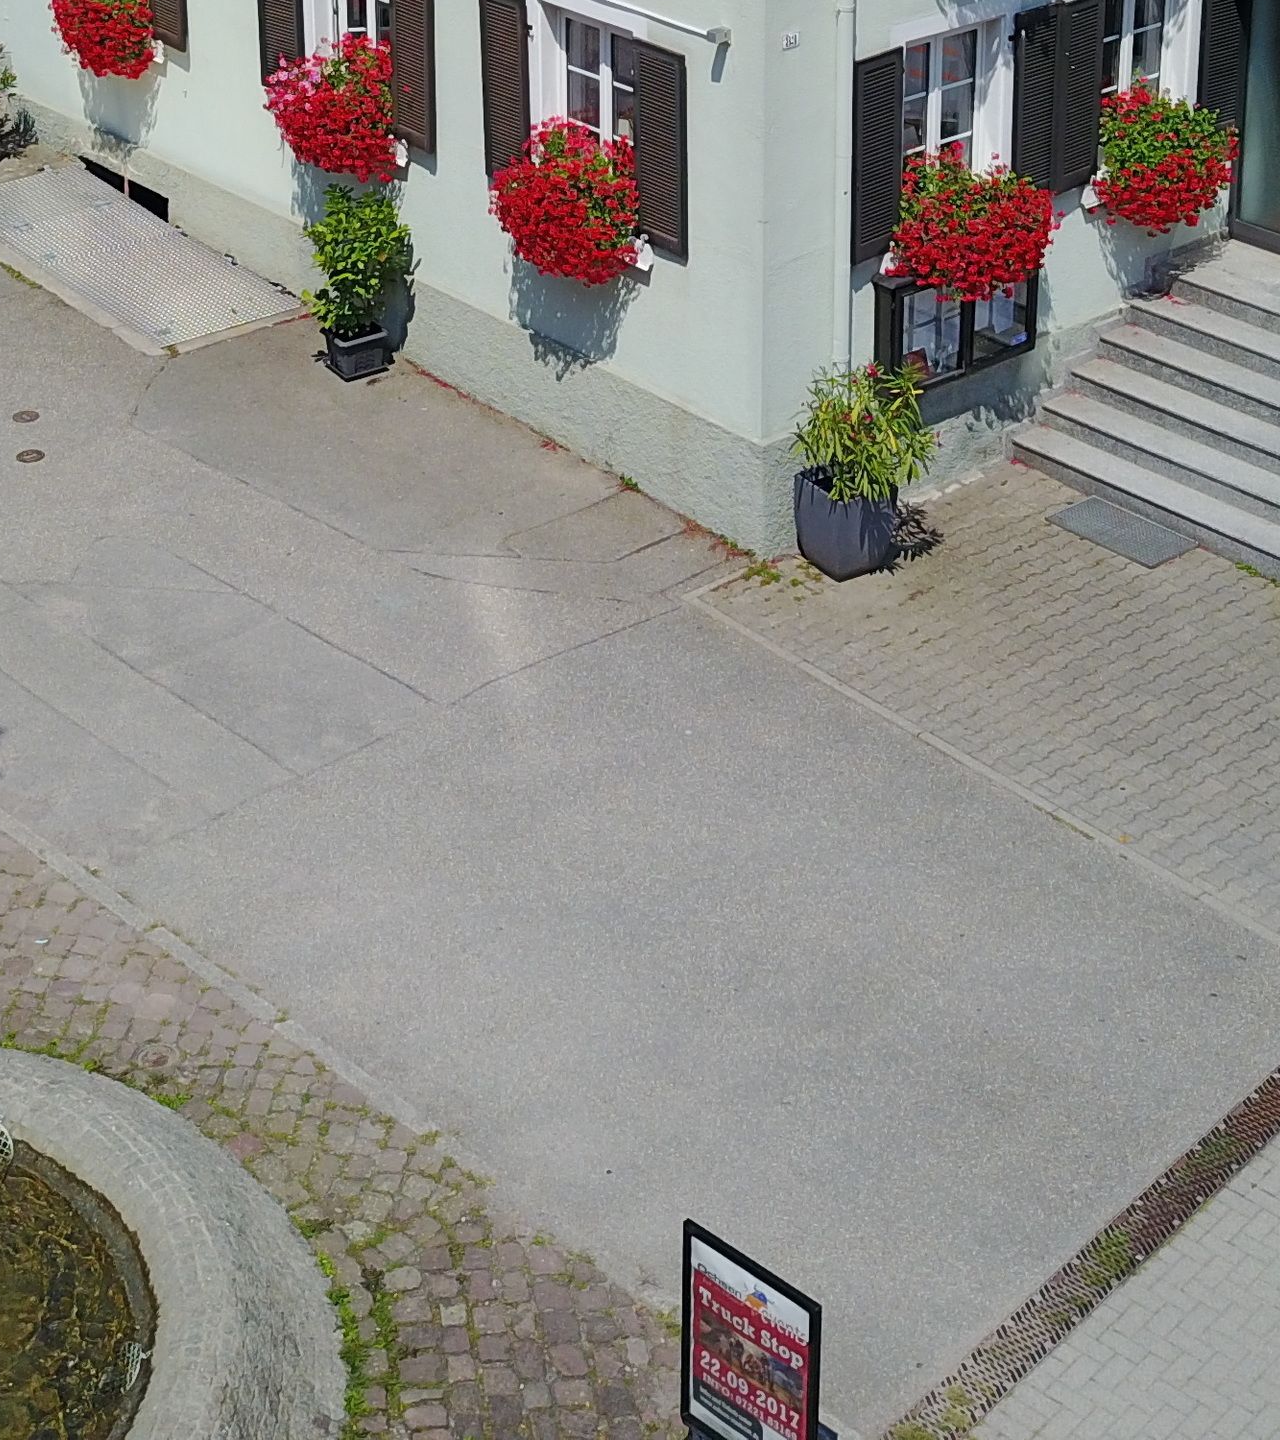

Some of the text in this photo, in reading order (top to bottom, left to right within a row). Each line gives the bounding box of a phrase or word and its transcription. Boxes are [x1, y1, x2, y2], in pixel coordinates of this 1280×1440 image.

[699, 1286, 756, 1339] Truck
[760, 1329, 805, 1370] Stop
[700, 1350, 800, 1429] 22.09.2017
